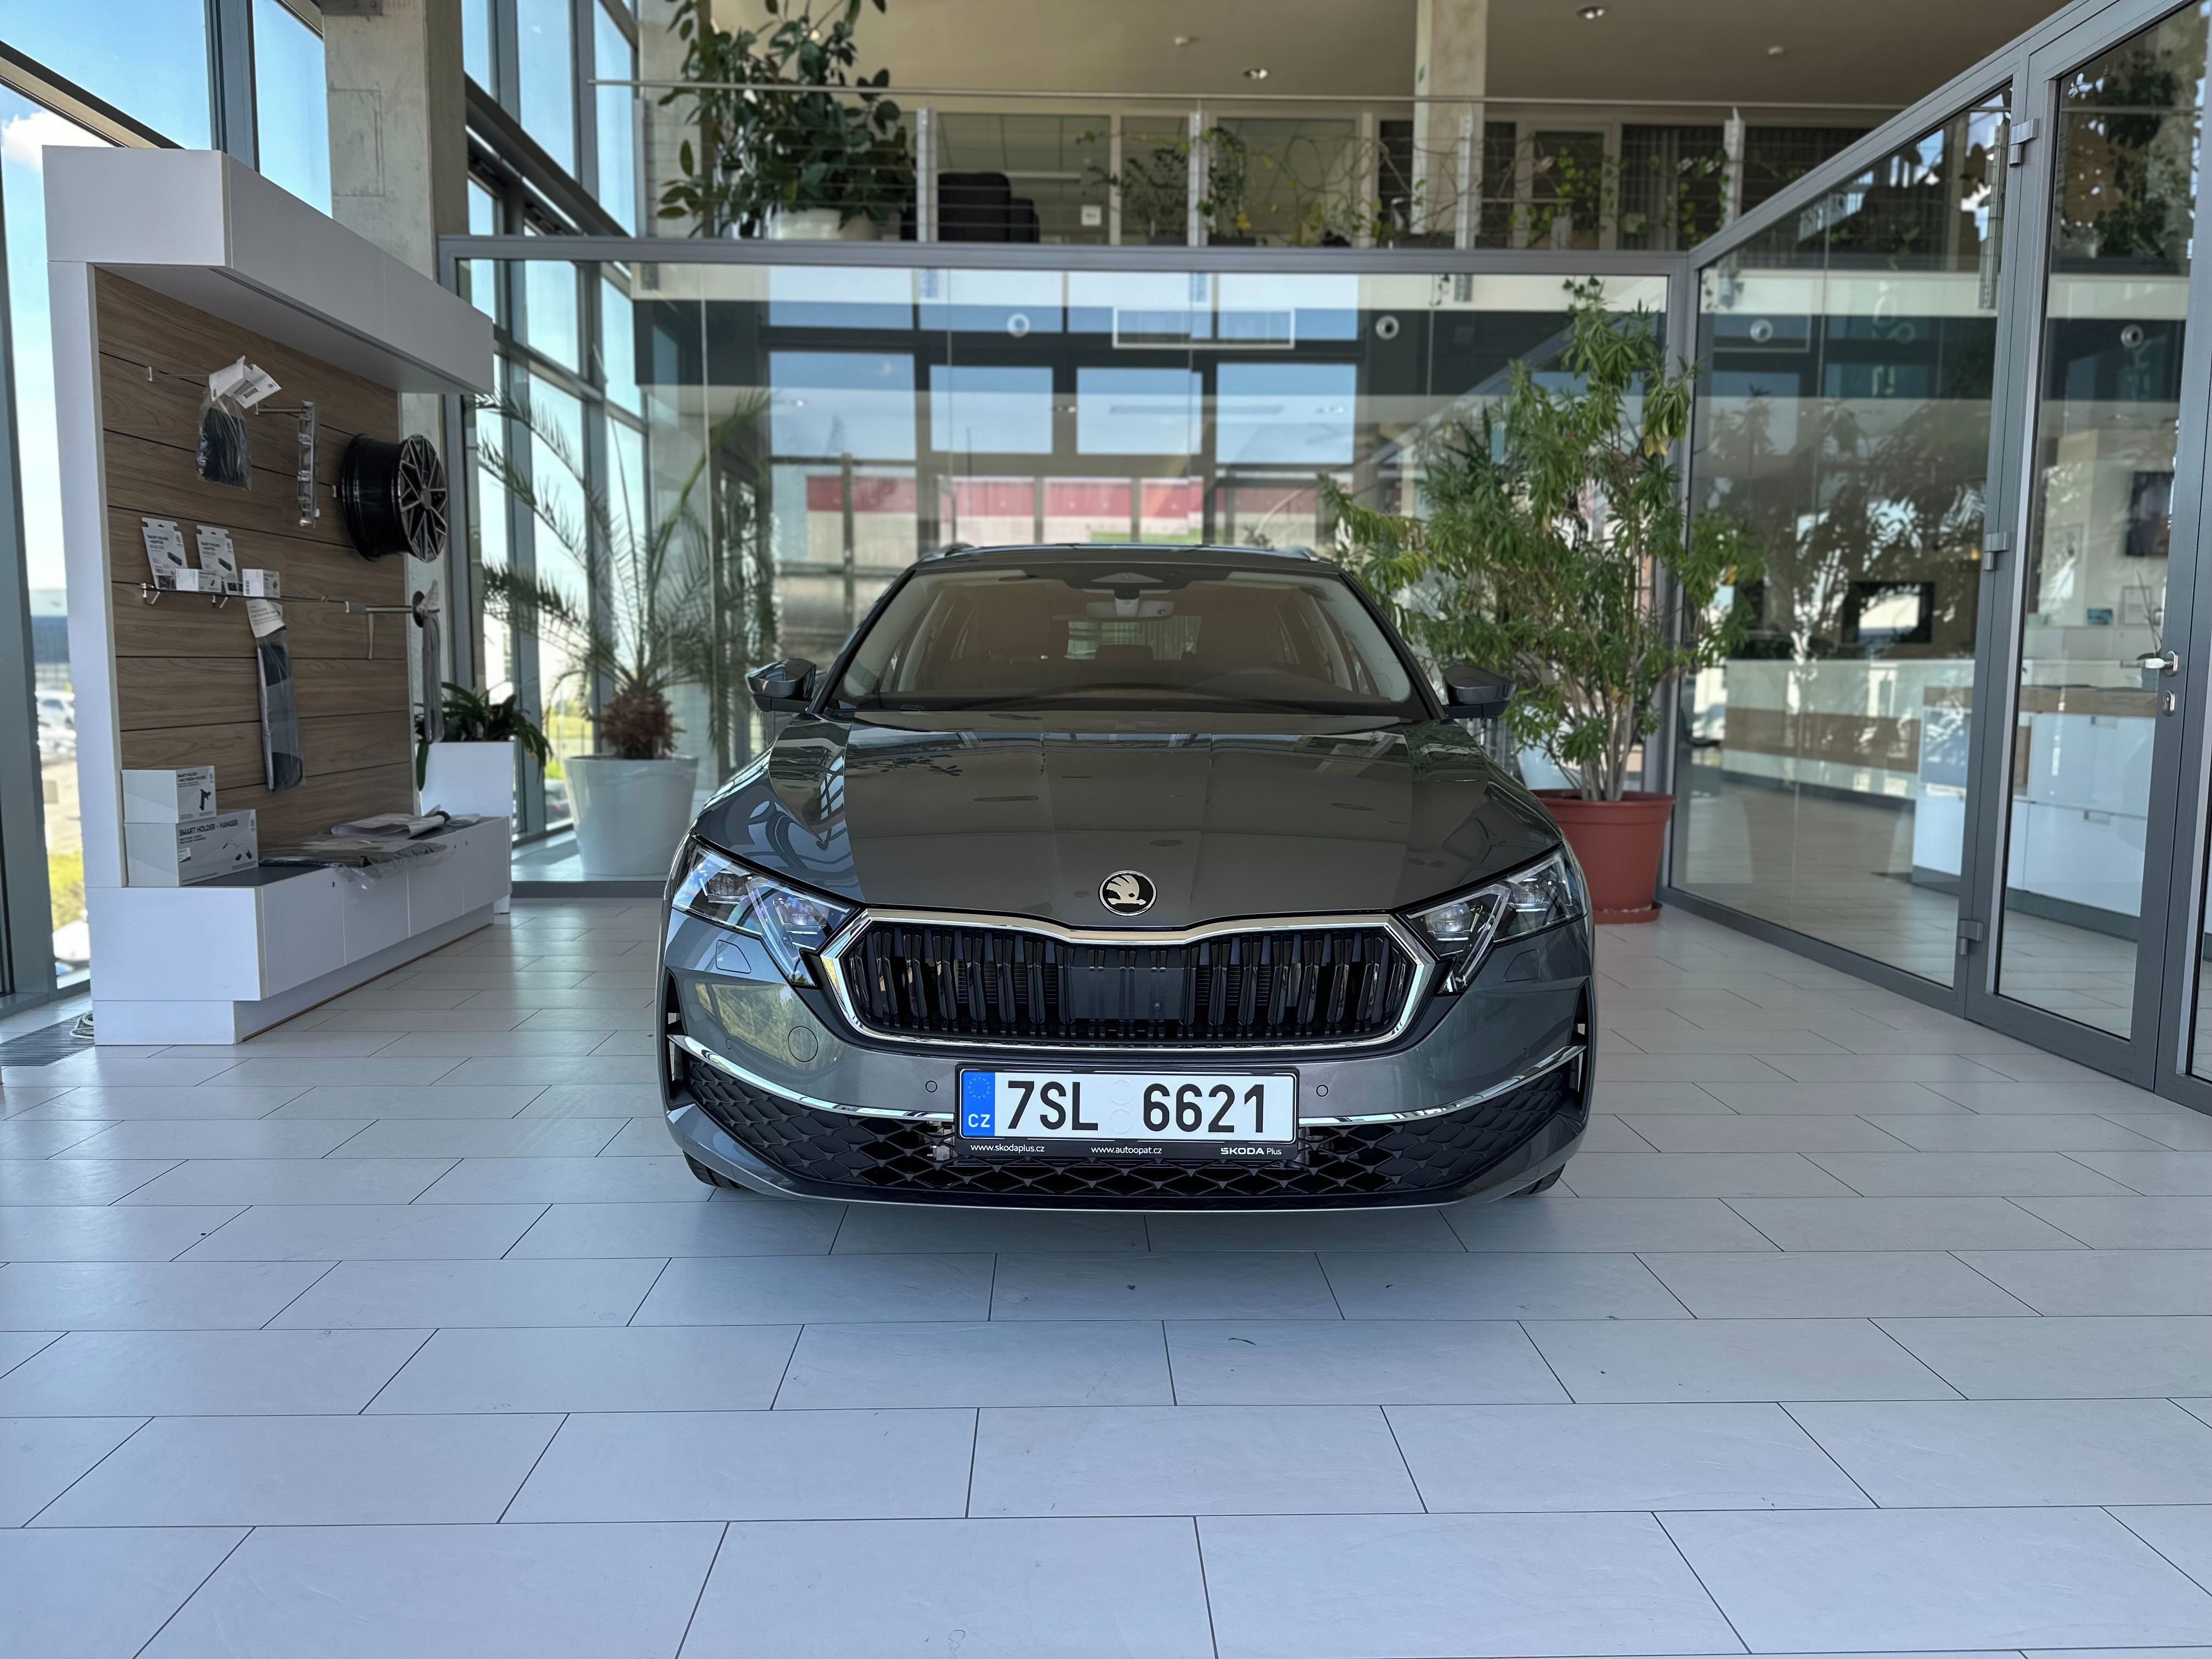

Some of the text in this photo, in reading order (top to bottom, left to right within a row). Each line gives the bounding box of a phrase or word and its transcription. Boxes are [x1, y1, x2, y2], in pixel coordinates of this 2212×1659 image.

[179, 827, 196, 836] SMART
[196, 823, 216, 833] HOLDER
[219, 819, 239, 829] HANGER
[1007, 1080, 1264, 1133] 7SL 6621
[968, 1113, 991, 1128] CZ
[970, 1143, 1045, 1154] www.skodaplus.cz
[1091, 1146, 1163, 1155] www.autoopat.cz
[1266, 1147, 1282, 1155] Plus
